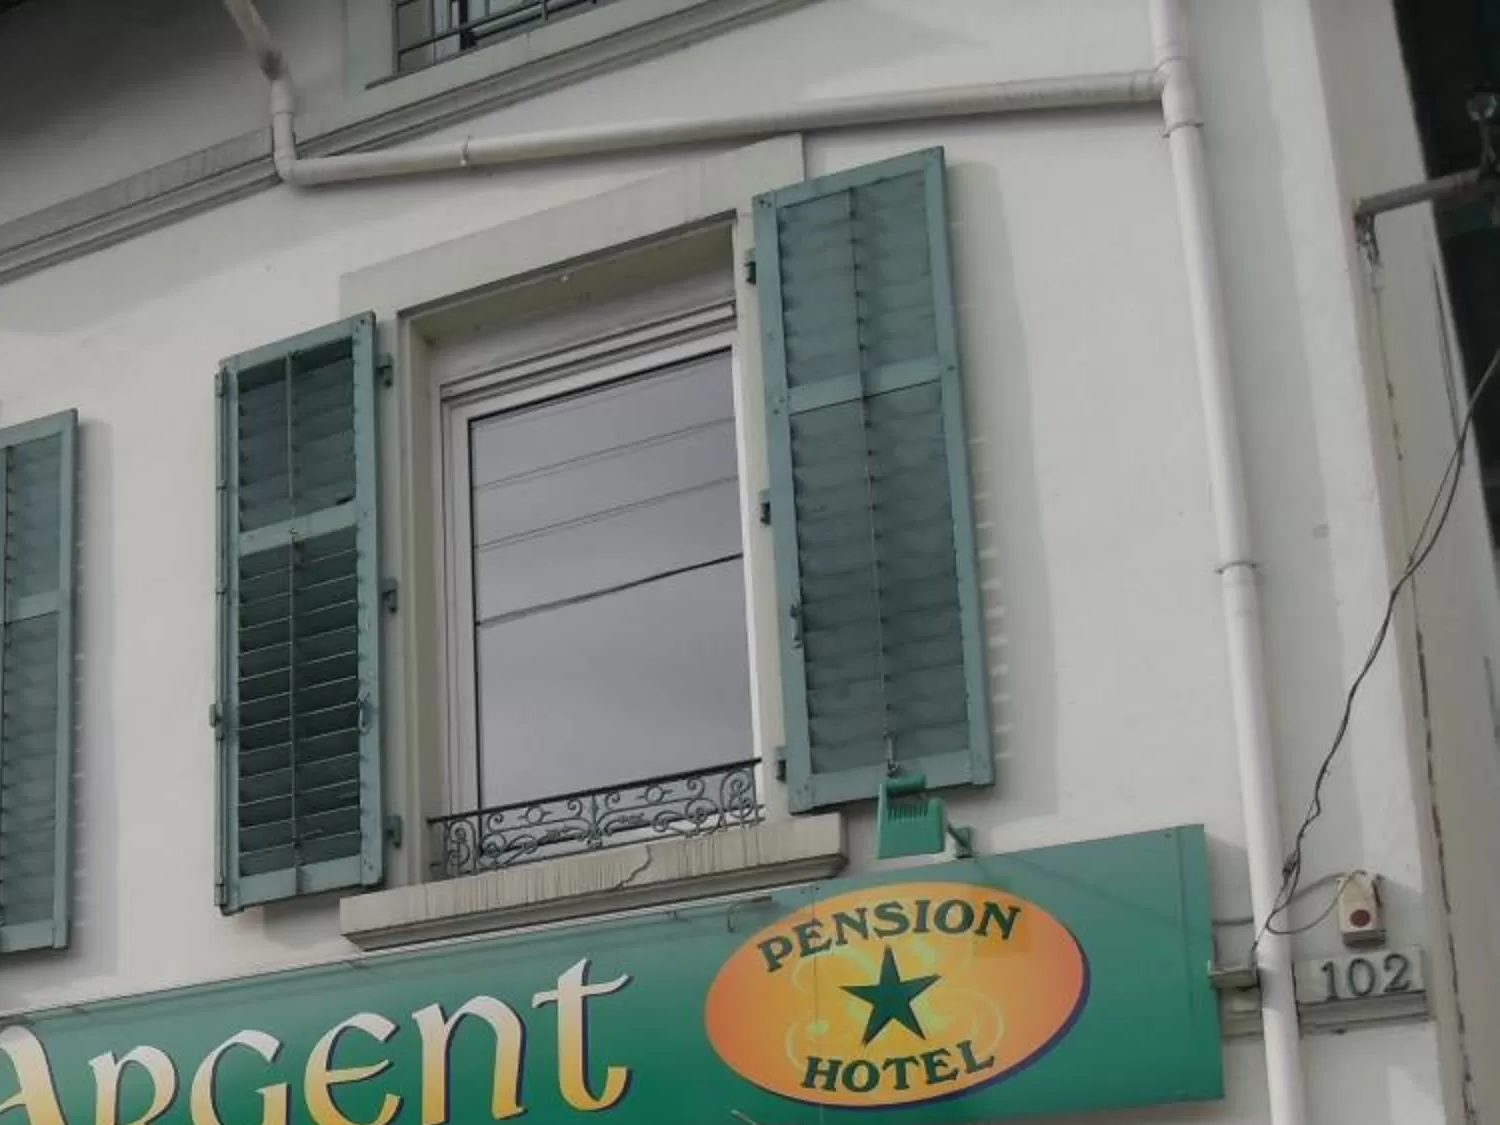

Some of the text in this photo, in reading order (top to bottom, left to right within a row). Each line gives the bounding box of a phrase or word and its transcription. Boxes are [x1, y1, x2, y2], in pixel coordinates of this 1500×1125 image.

[756, 899, 1021, 973] PENSION
[1321, 953, 1411, 1001] 102
[800, 1039, 996, 1092] HOTEL
